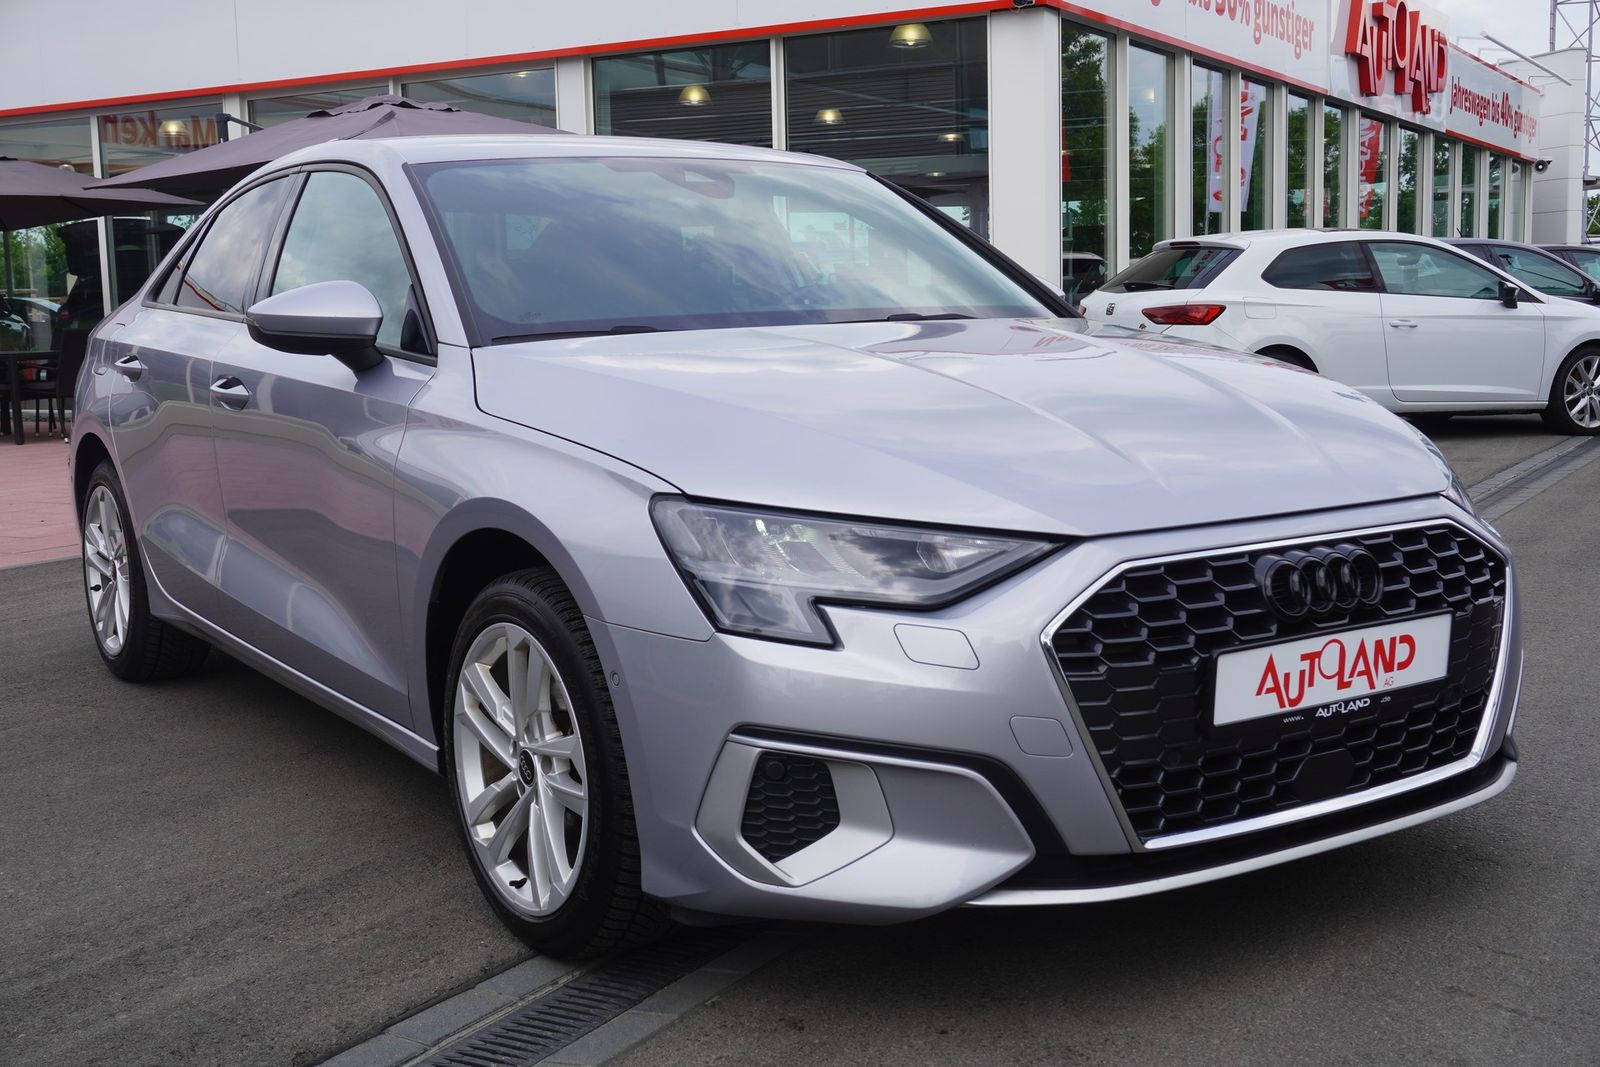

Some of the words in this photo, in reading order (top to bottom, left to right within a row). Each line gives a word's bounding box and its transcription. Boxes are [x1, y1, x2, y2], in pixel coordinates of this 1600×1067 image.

[1450, 75, 1490, 127] Jahreswagen
[1492, 92, 1500, 124] bis
[1255, 634, 1416, 709] AUTOLAND
[1383, 676, 1394, 687] AG
[1315, 698, 1370, 717] AUTOLAND
